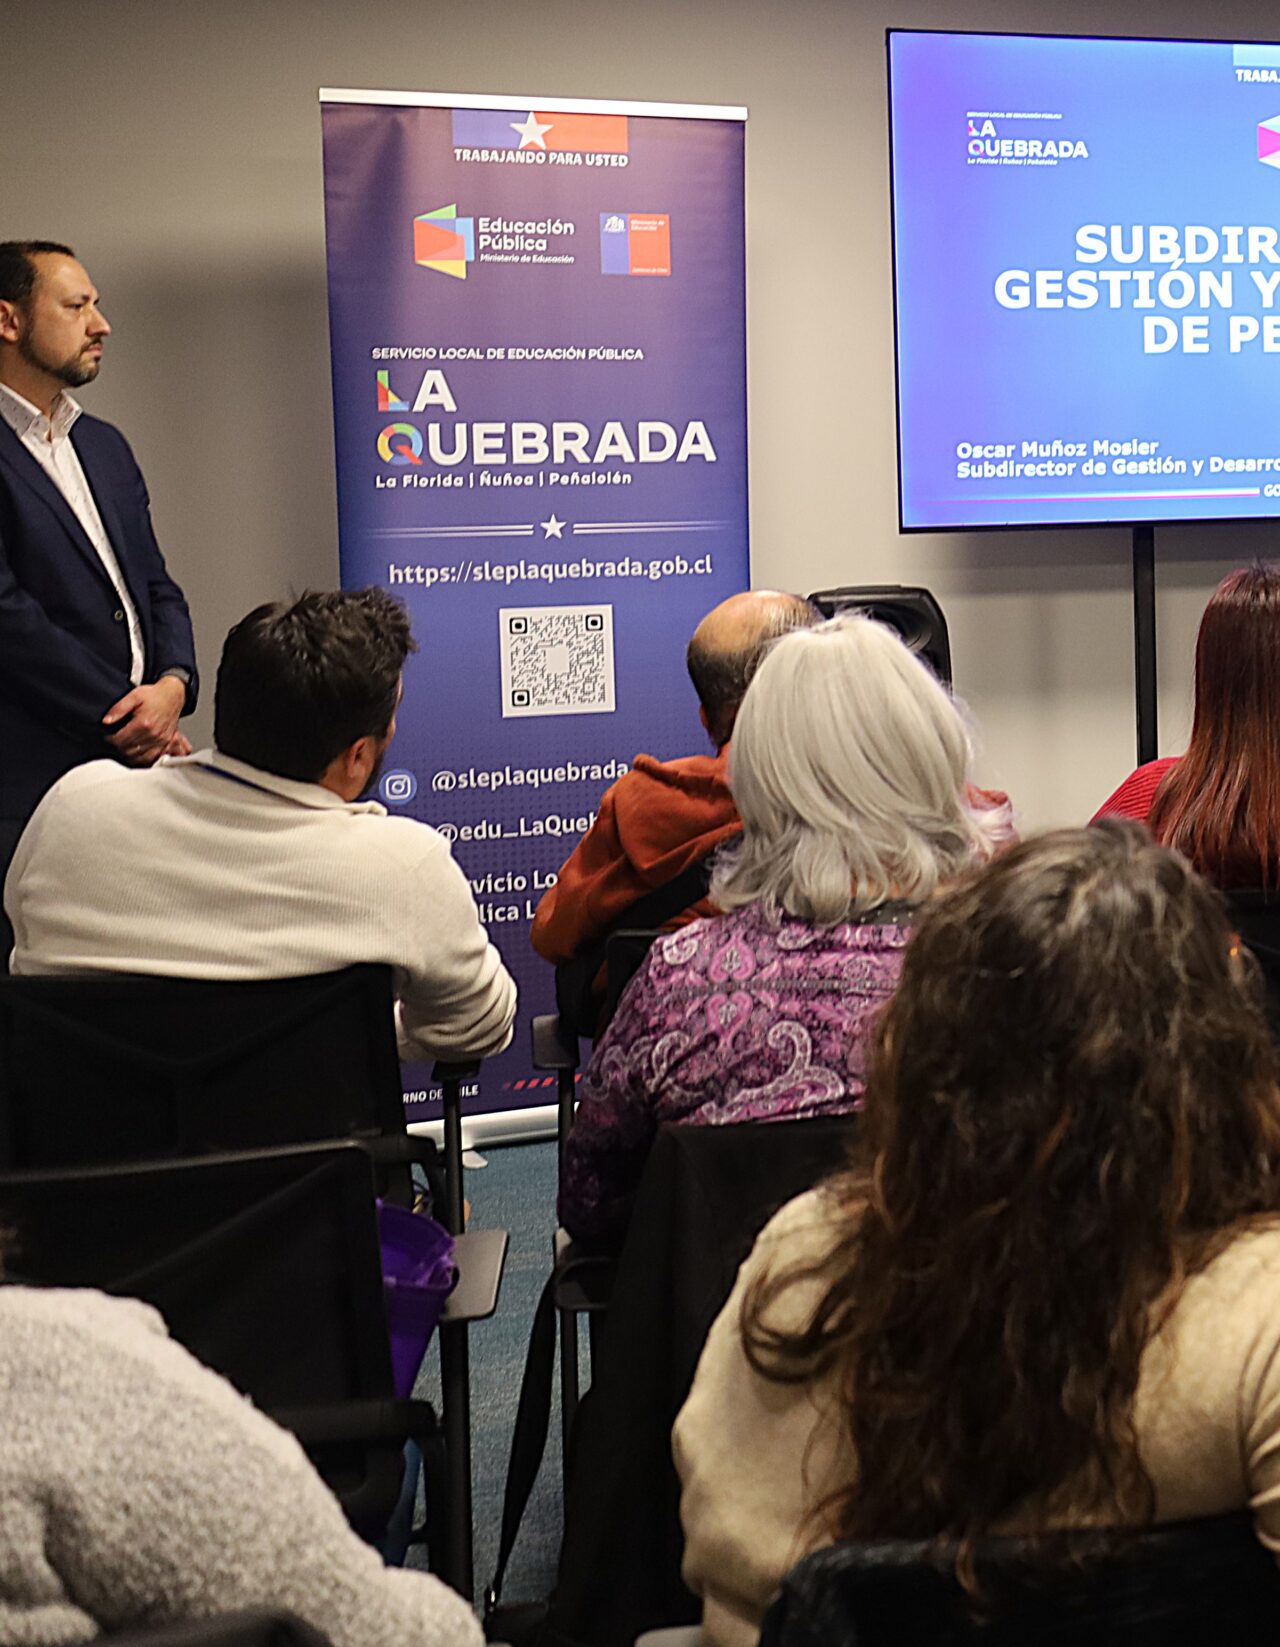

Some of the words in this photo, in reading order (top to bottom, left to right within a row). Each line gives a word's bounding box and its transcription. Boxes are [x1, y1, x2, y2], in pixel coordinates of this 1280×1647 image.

[968, 119, 996, 137] LA
[453, 148, 546, 165] TRABAJANDO
[548, 151, 583, 166] PARA
[585, 154, 629, 168] USTED
[968, 139, 1088, 158] QUEBRADA
[478, 216, 575, 236] Educación
[479, 234, 547, 251] Pública
[994, 258, 1233, 309] GESTIÓN
[1143, 315, 1210, 353] DE
[371, 347, 436, 360] SERVICIO
[439, 348, 484, 360] LOCAL
[487, 348, 505, 360] DE
[507, 346, 586, 360] EDUCACIÓN
[588, 346, 644, 360] PÚBLICA
[376, 369, 457, 412] LA
[377, 421, 717, 466] QUEBRADA
[956, 442, 1016, 459] Oscar
[1021, 440, 1087, 458] Muñoz
[956, 459, 1077, 479] Subdirector
[1081, 458, 1107, 476] de
[1111, 455, 1187, 475] Gestión
[1191, 457, 1205, 477] y
[375, 474, 396, 489] La
[402, 473, 464, 488] Florida
[479, 470, 534, 487] Ñuñoa
[549, 470, 632, 486] Peñalolén
[388, 554, 713, 588] https://sleplaquebrada.gob.cl
[432, 759, 629, 792] @sleplaquebrada
[469, 871, 527, 894] vicio
